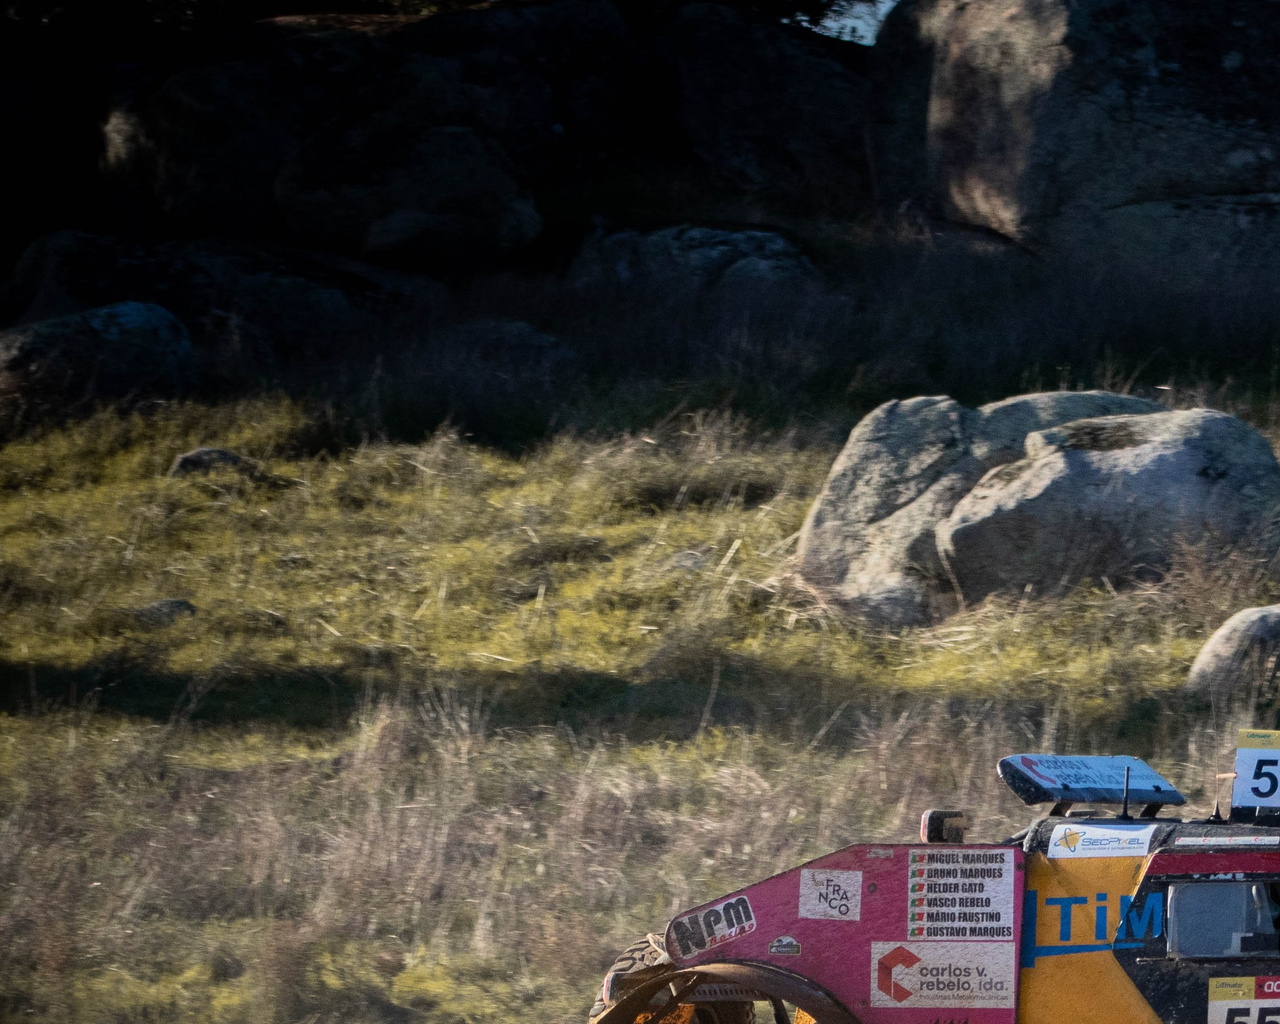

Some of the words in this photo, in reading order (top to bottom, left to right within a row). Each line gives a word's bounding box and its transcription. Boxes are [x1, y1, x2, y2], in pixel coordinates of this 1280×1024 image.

[927, 853, 960, 864] MIGUEL
[962, 853, 1005, 865] MARQUES
[927, 868, 957, 878] BRUNO
[960, 868, 1003, 879] MARQUES
[927, 883, 959, 893] HELDER
[961, 883, 984, 893] GATO
[927, 897, 956, 908] VASCO
[959, 897, 991, 908] REBELO
[927, 910, 956, 922] MÁRIO
[958, 912, 1001, 922] FAUSTINO
[927, 927, 967, 937] GUSTAVO
[969, 927, 1012, 938] MARQUES
[919, 963, 971, 977] carlos
[976, 966, 987, 978] v.
